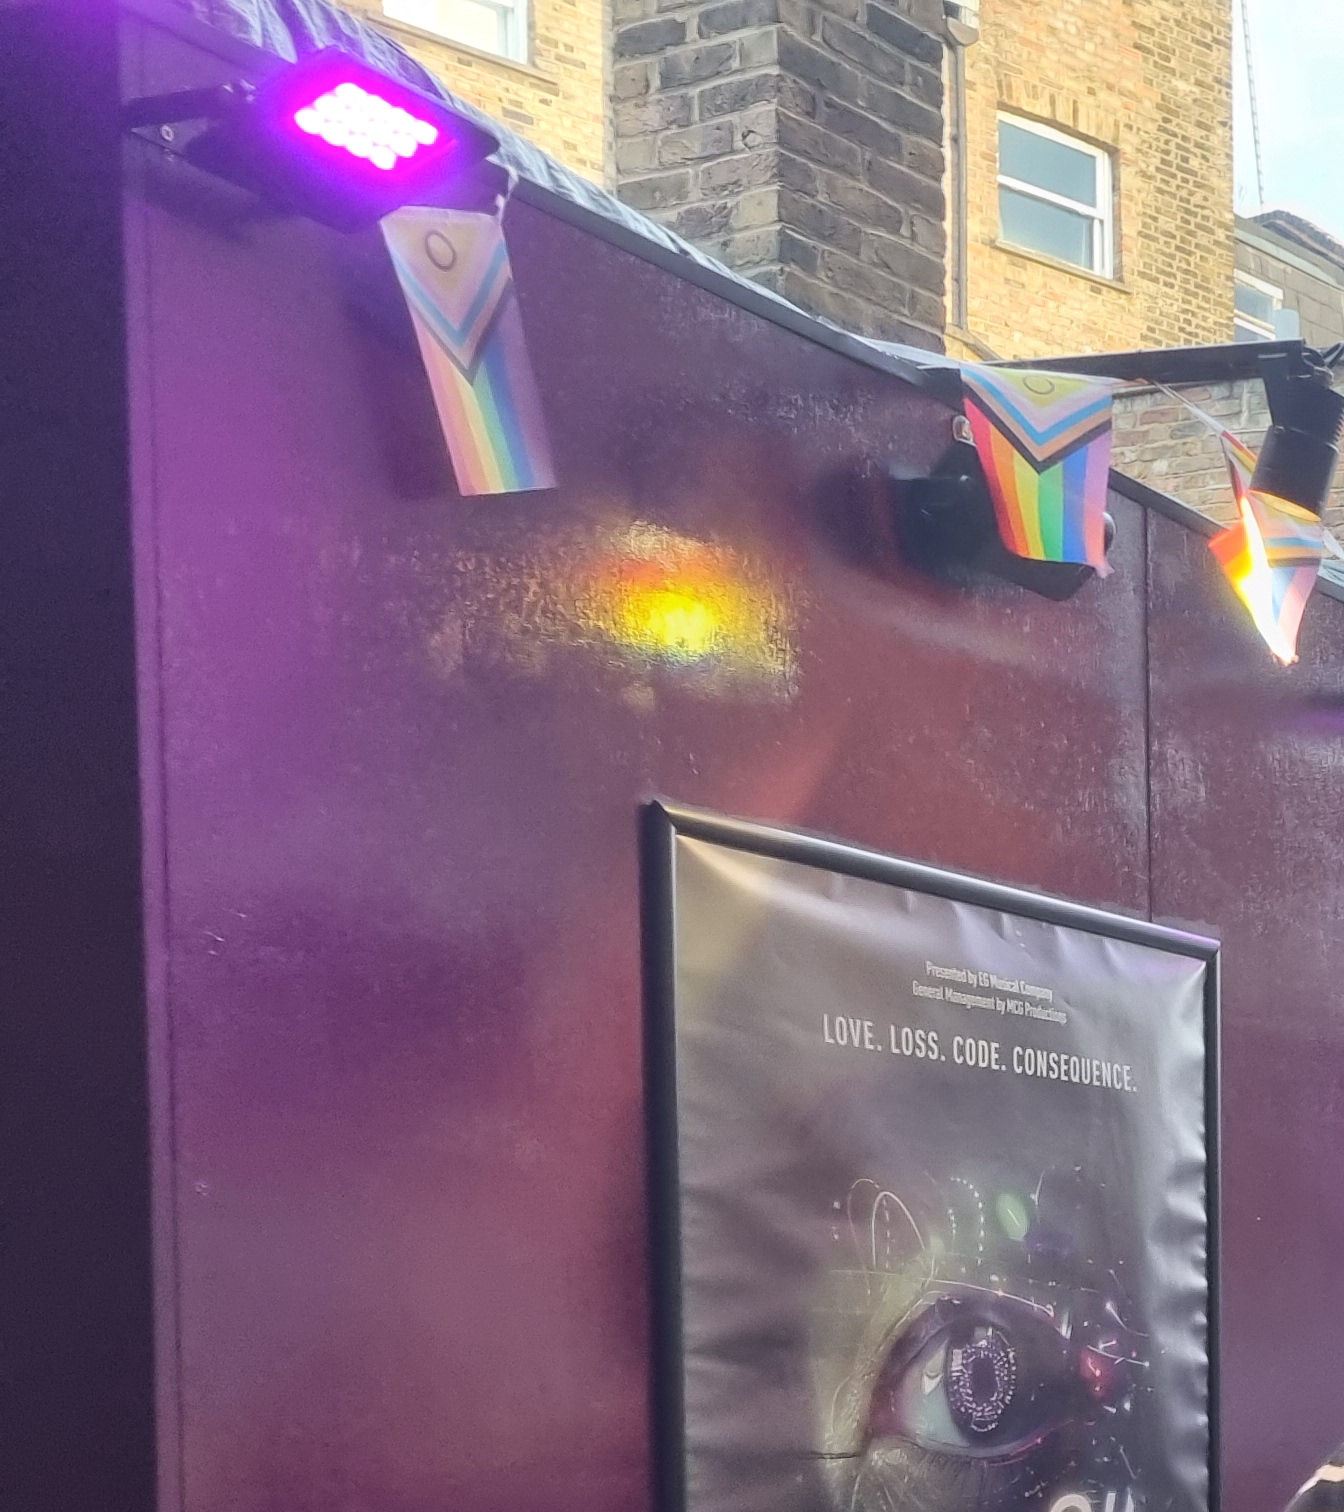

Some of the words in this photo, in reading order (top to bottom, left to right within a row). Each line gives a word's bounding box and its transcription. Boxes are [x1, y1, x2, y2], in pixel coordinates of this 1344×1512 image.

[912, 980, 944, 1000] General
[945, 986, 995, 1010] Management
[996, 997, 1006, 1015] by
[1007, 998, 1024, 1016] MCG
[1024, 1001, 1067, 1025] Productions
[926, 960, 967, 983] Presented
[967, 969, 977, 988] by
[979, 971, 989, 987] EG
[1020, 981, 1053, 1002] Company
[822, 1014, 882, 1051] LOVE.
[890, 1024, 946, 1061] LOSS.
[953, 1035, 1006, 1071] CODE.
[1013, 1046, 1138, 1092] CONSEQUENCE.
